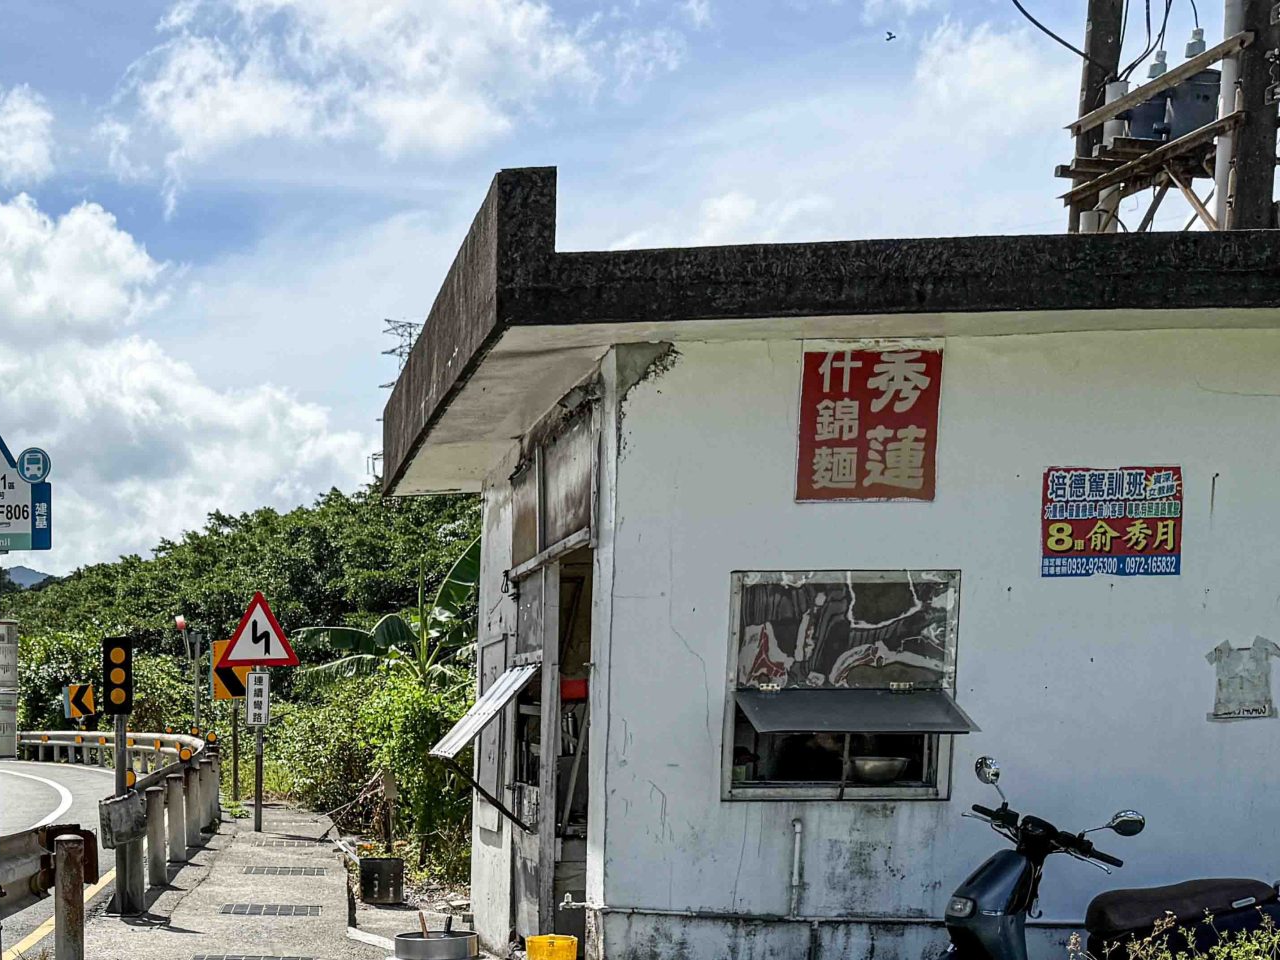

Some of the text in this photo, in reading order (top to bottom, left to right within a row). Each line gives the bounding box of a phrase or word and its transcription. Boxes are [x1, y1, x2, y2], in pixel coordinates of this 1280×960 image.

[811, 350, 862, 490] 什錦麵
[863, 351, 931, 490] 秀蓮
[1048, 471, 1145, 499] 培德駕訓班
[1086, 520, 1176, 552] 俞秀月
